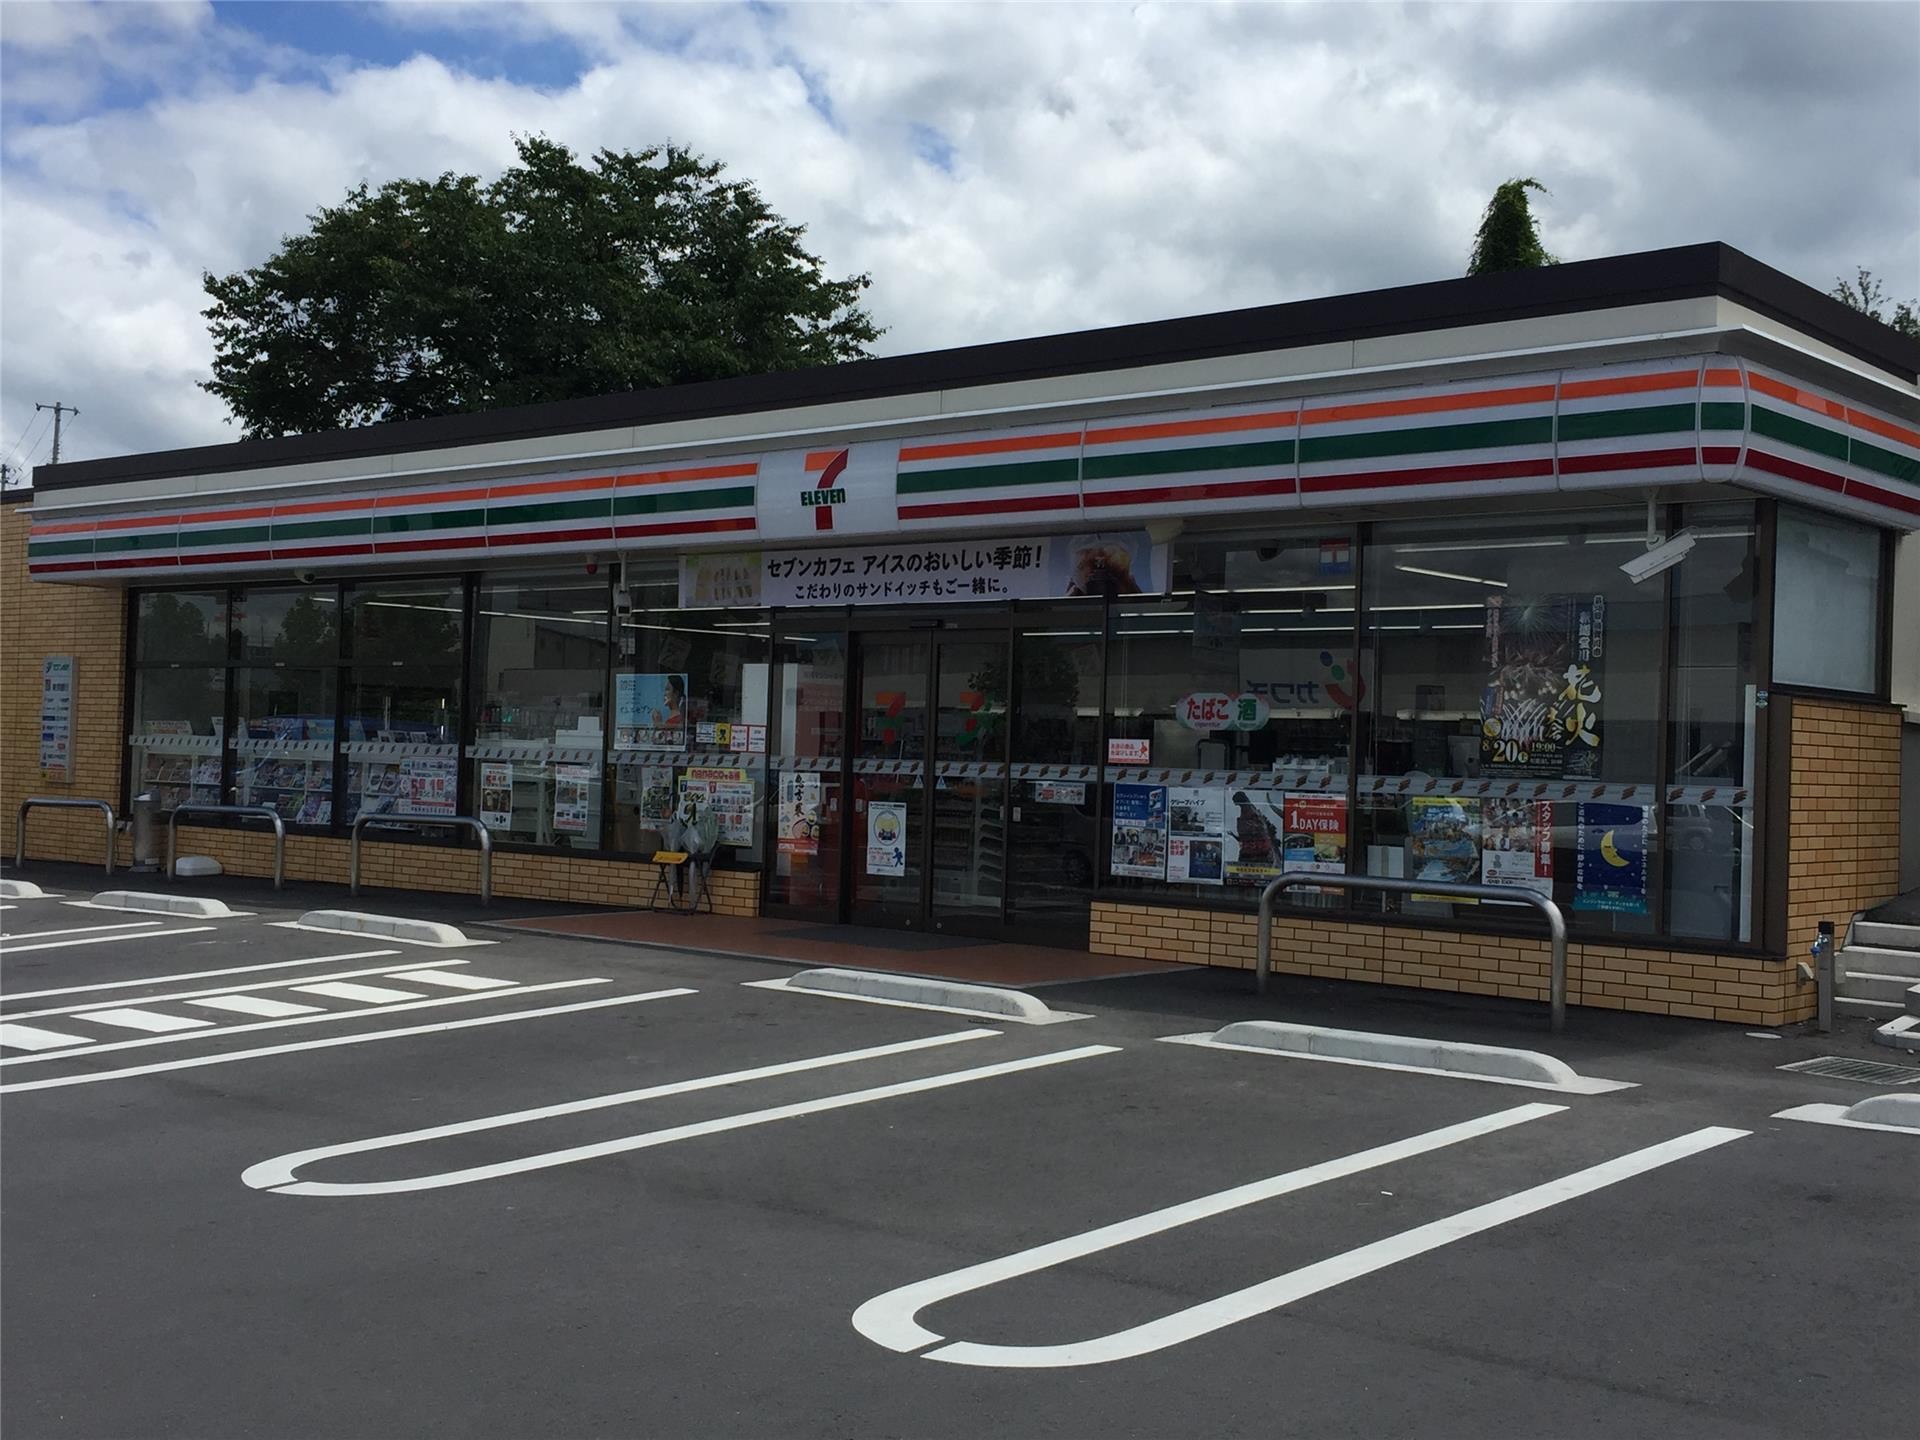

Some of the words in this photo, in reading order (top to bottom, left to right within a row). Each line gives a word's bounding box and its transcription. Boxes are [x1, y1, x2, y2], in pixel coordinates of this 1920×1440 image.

[804, 448, 849, 530] 7
[767, 555, 855, 579] セブンカフェ
[862, 544, 1043, 576] アイスのおいしい季節！
[794, 576, 1010, 601] こだわりのサンドイッチもご一緒に。
[1187, 698, 1228, 721] たばこ
[1238, 698, 1257, 721] 酒
[1557, 663, 1602, 748] 花火
[1492, 740, 1520, 764] 20
[1290, 809, 1339, 833] 1DAY保険
